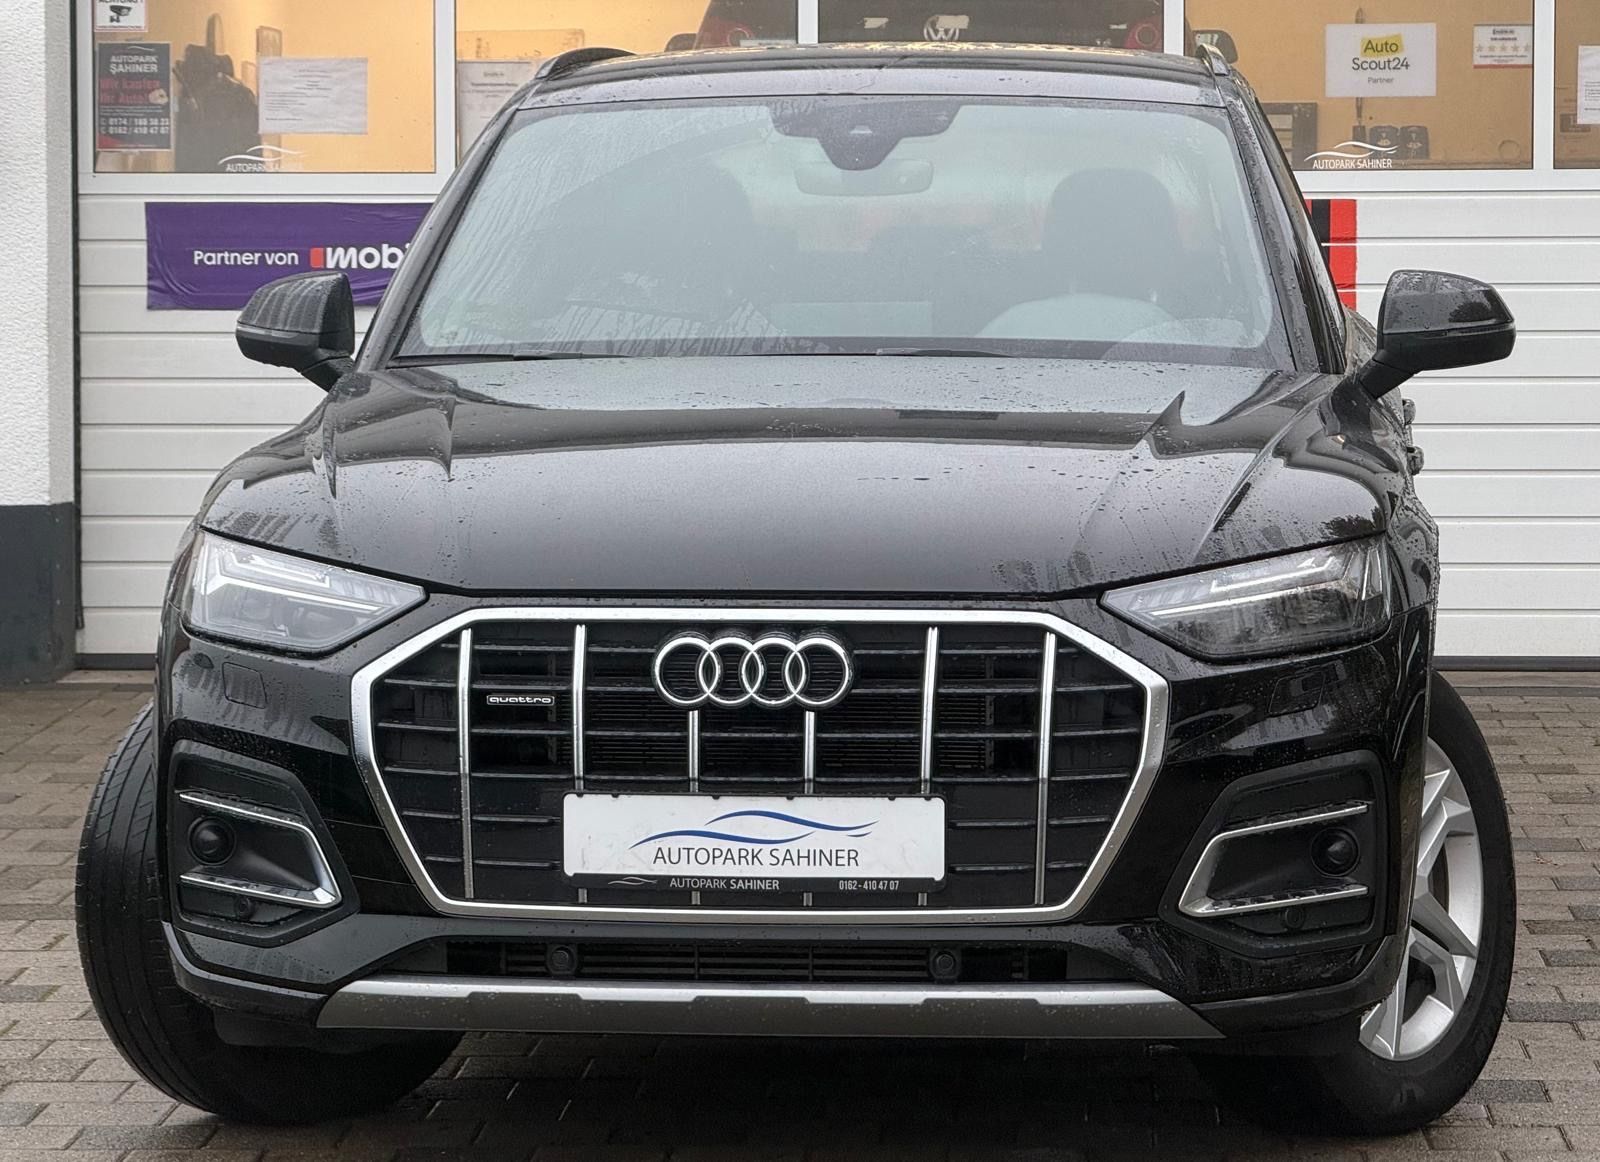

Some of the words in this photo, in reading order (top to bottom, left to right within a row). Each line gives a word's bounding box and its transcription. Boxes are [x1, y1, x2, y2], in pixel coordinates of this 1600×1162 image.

[1363, 39, 1399, 53] Auto
[110, 55, 159, 63] AUTOPARK
[1352, 57, 1410, 71] Scout24
[1312, 159, 1356, 169] AUTOPARK
[1357, 158, 1393, 169] SAHINER
[193, 250, 261, 265] Partner
[264, 252, 299, 265] von
[325, 243, 410, 269] mob
[652, 846, 763, 865] AUTOPARK
[768, 848, 860, 867] SAHINER
[669, 877, 727, 889] AUTOPARK
[729, 878, 780, 890] SAHINER
